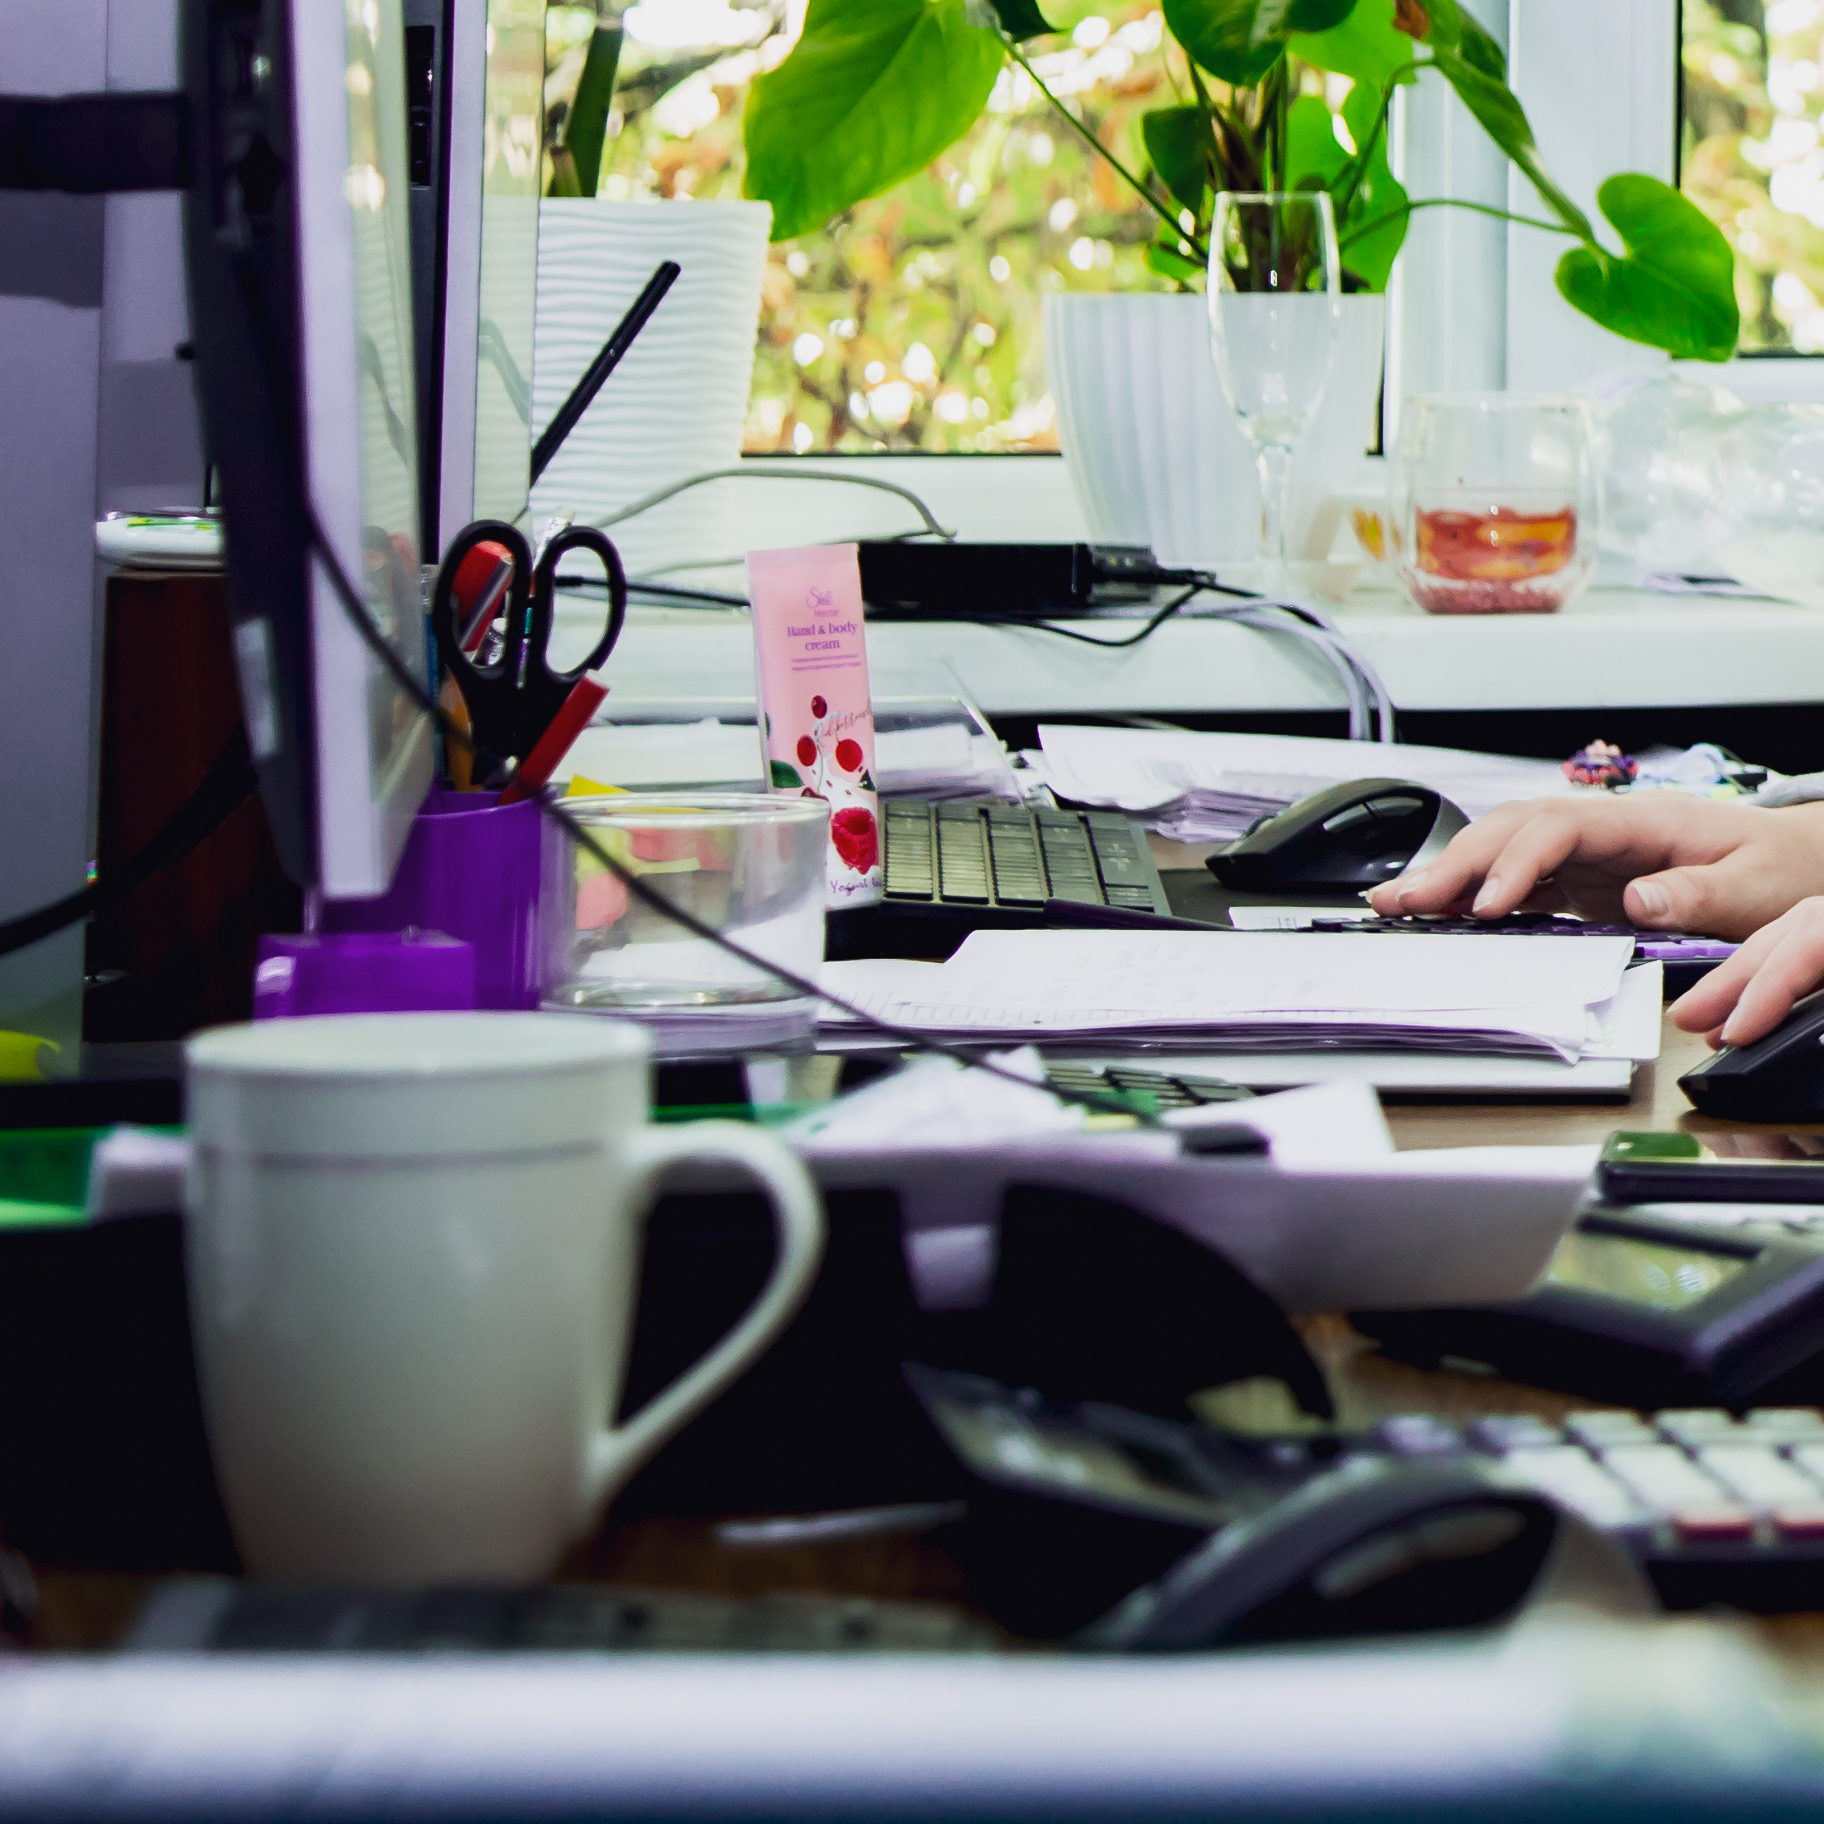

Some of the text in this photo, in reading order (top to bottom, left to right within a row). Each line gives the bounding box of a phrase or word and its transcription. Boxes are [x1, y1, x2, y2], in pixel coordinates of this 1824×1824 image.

[787, 621, 857, 637] Hand & body
[804, 640, 840, 651] cream
